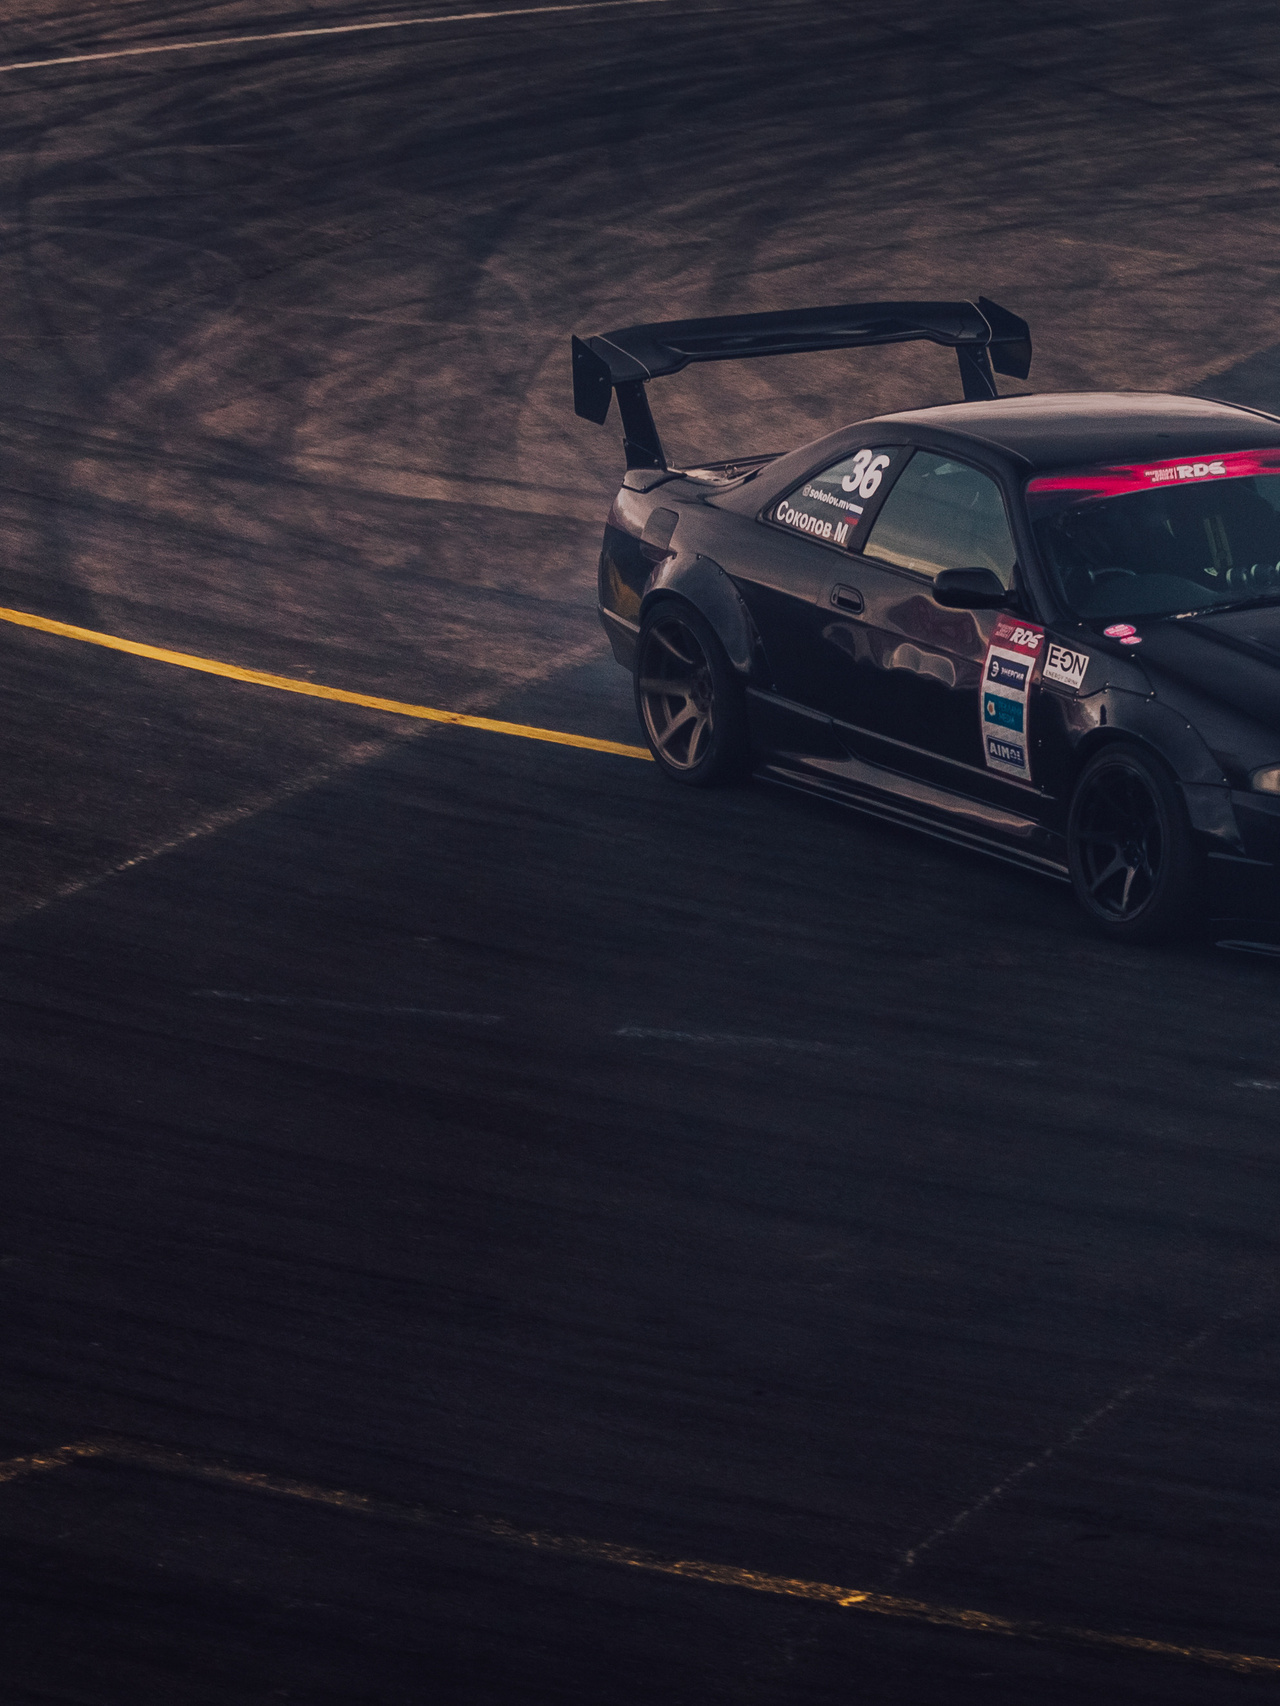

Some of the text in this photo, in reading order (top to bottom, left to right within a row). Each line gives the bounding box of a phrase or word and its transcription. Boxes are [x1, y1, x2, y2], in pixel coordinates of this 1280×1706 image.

[841, 449, 890, 499] 36
[1176, 461, 1226, 479] RDS
[776, 500, 833, 538] Соколов
[1009, 627, 1045, 649] RDS
